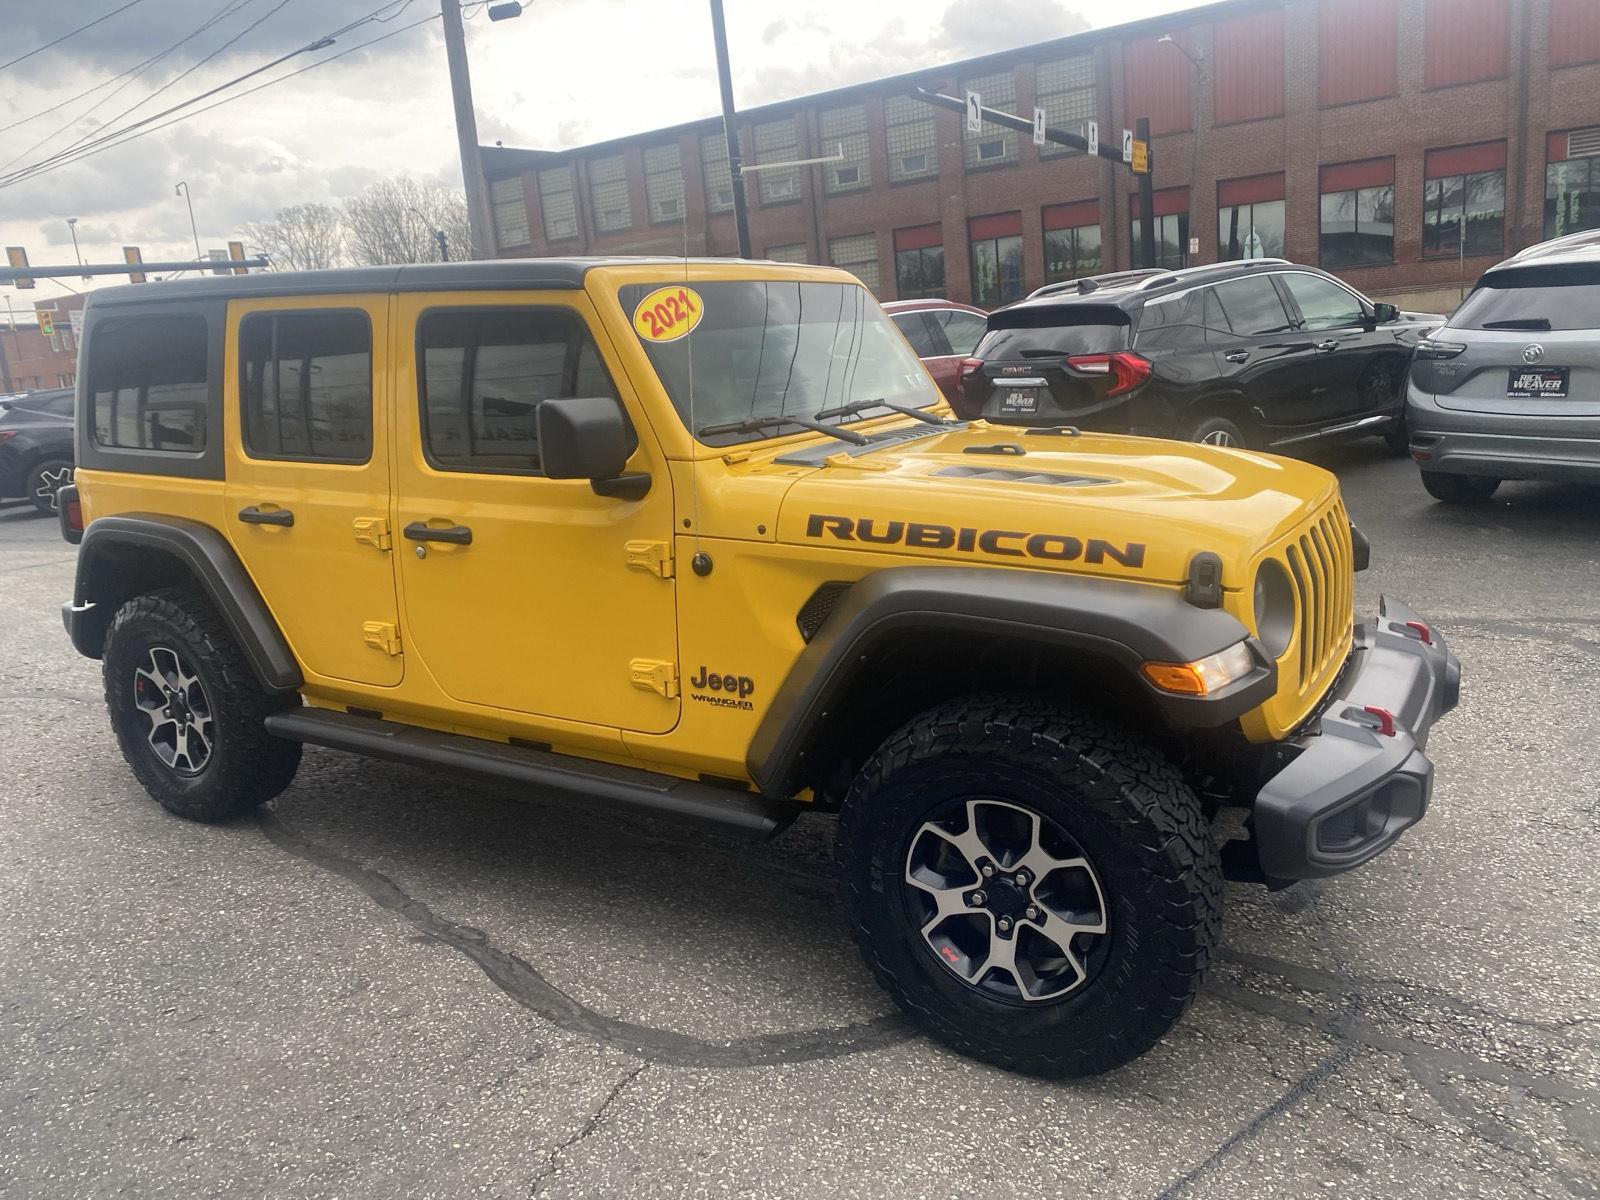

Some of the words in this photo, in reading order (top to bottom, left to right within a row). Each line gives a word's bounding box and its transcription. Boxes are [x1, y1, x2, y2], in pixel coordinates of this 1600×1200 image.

[641, 290, 696, 338] 2021
[1513, 380, 1562, 389] WEAVER
[806, 513, 1147, 569] RUBICON
[690, 665, 755, 699] Jeep
[690, 693, 754, 708] WRANGLER
